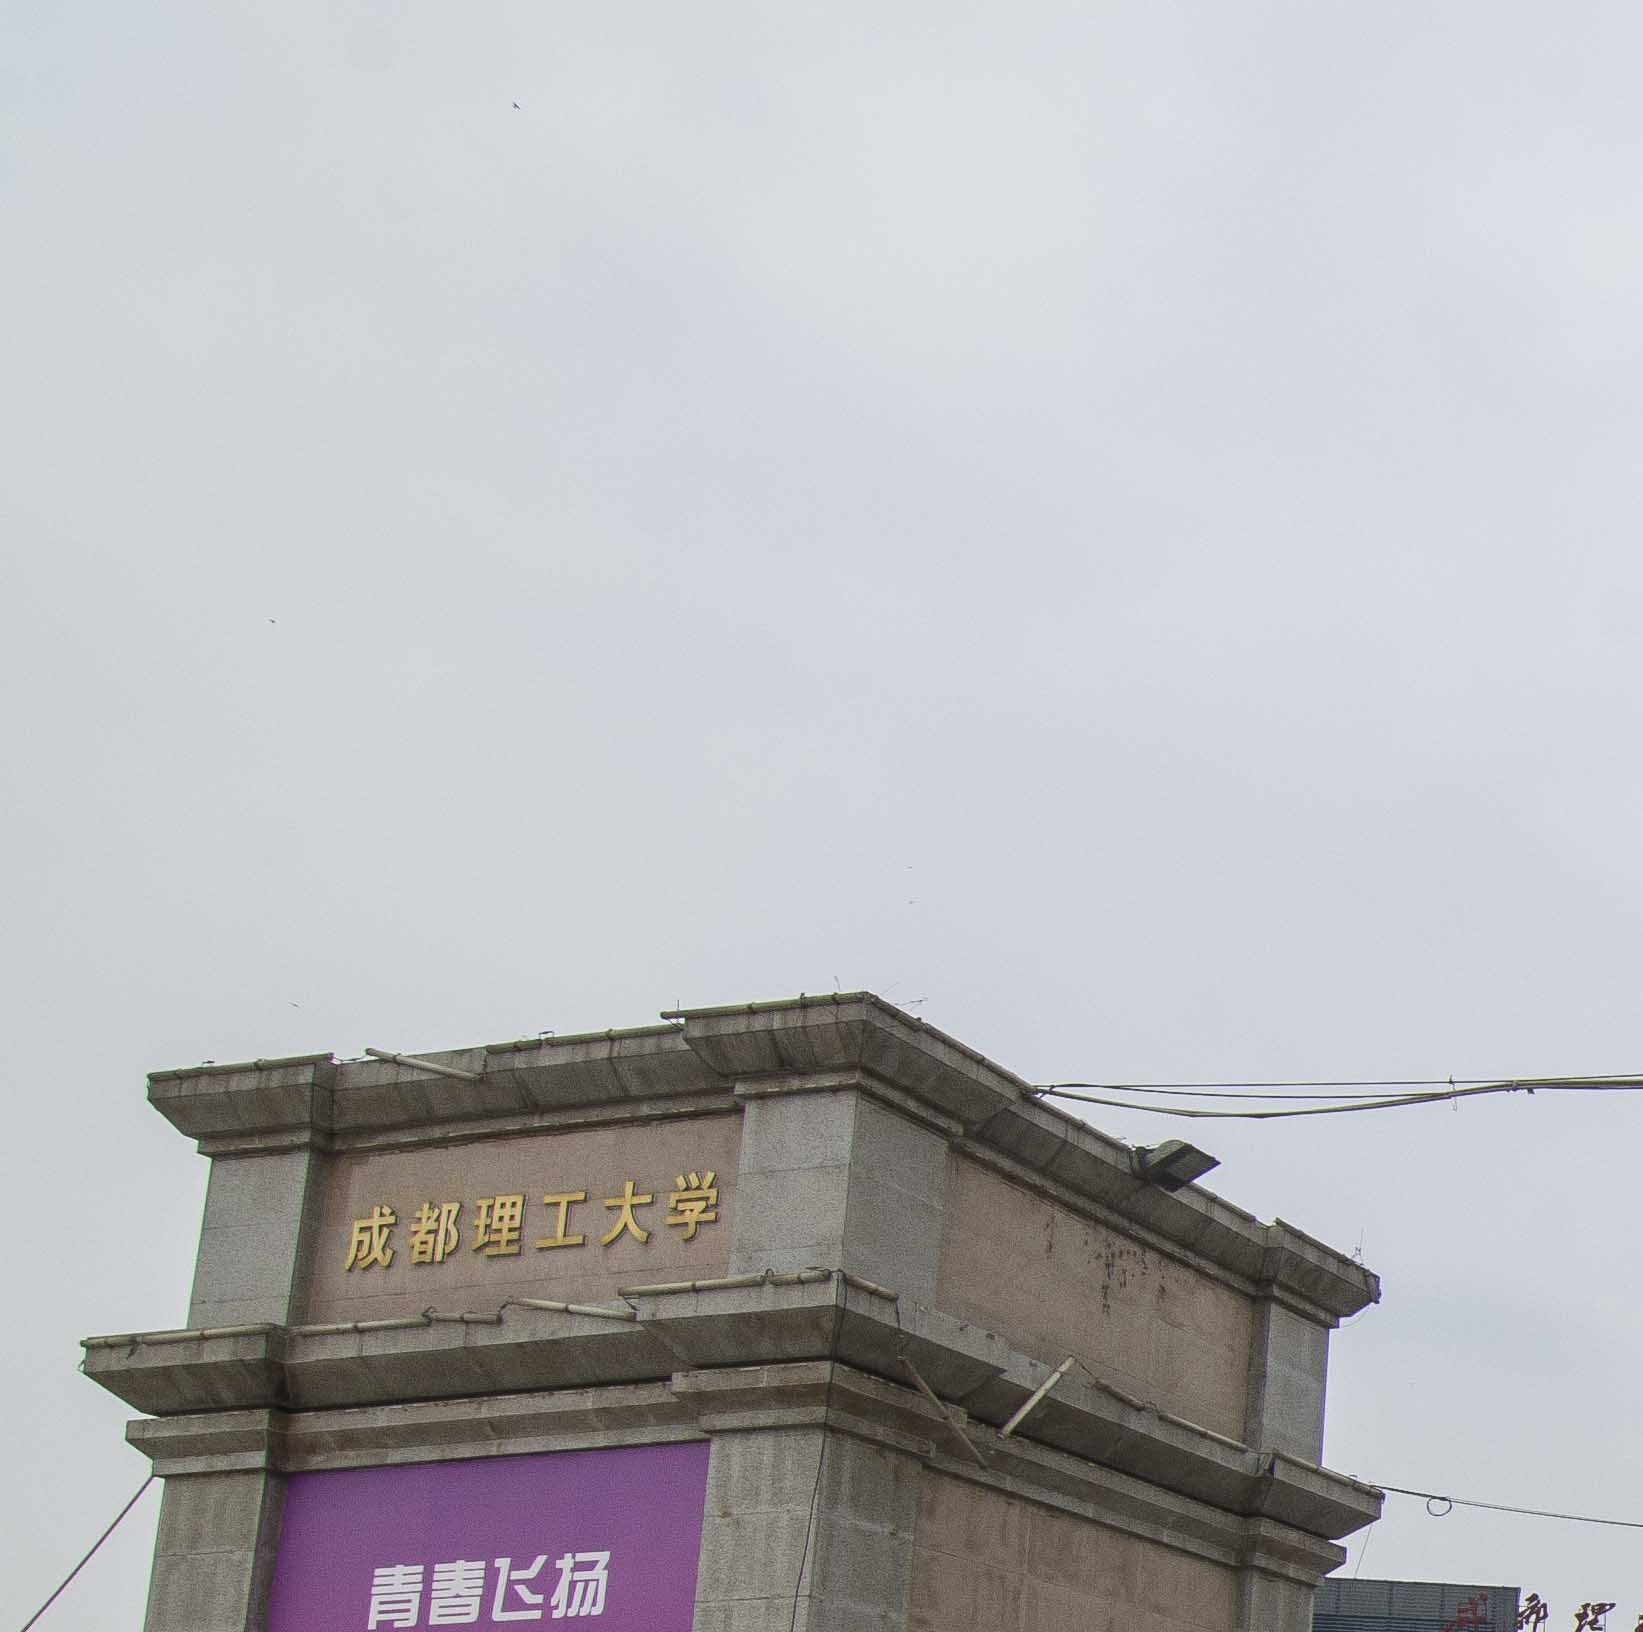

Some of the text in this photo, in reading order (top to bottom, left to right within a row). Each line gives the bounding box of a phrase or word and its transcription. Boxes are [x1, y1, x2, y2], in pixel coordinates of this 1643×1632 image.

[344, 1170, 720, 1271] 成都理工大学
[367, 1551, 611, 1630] 青春飞扬
